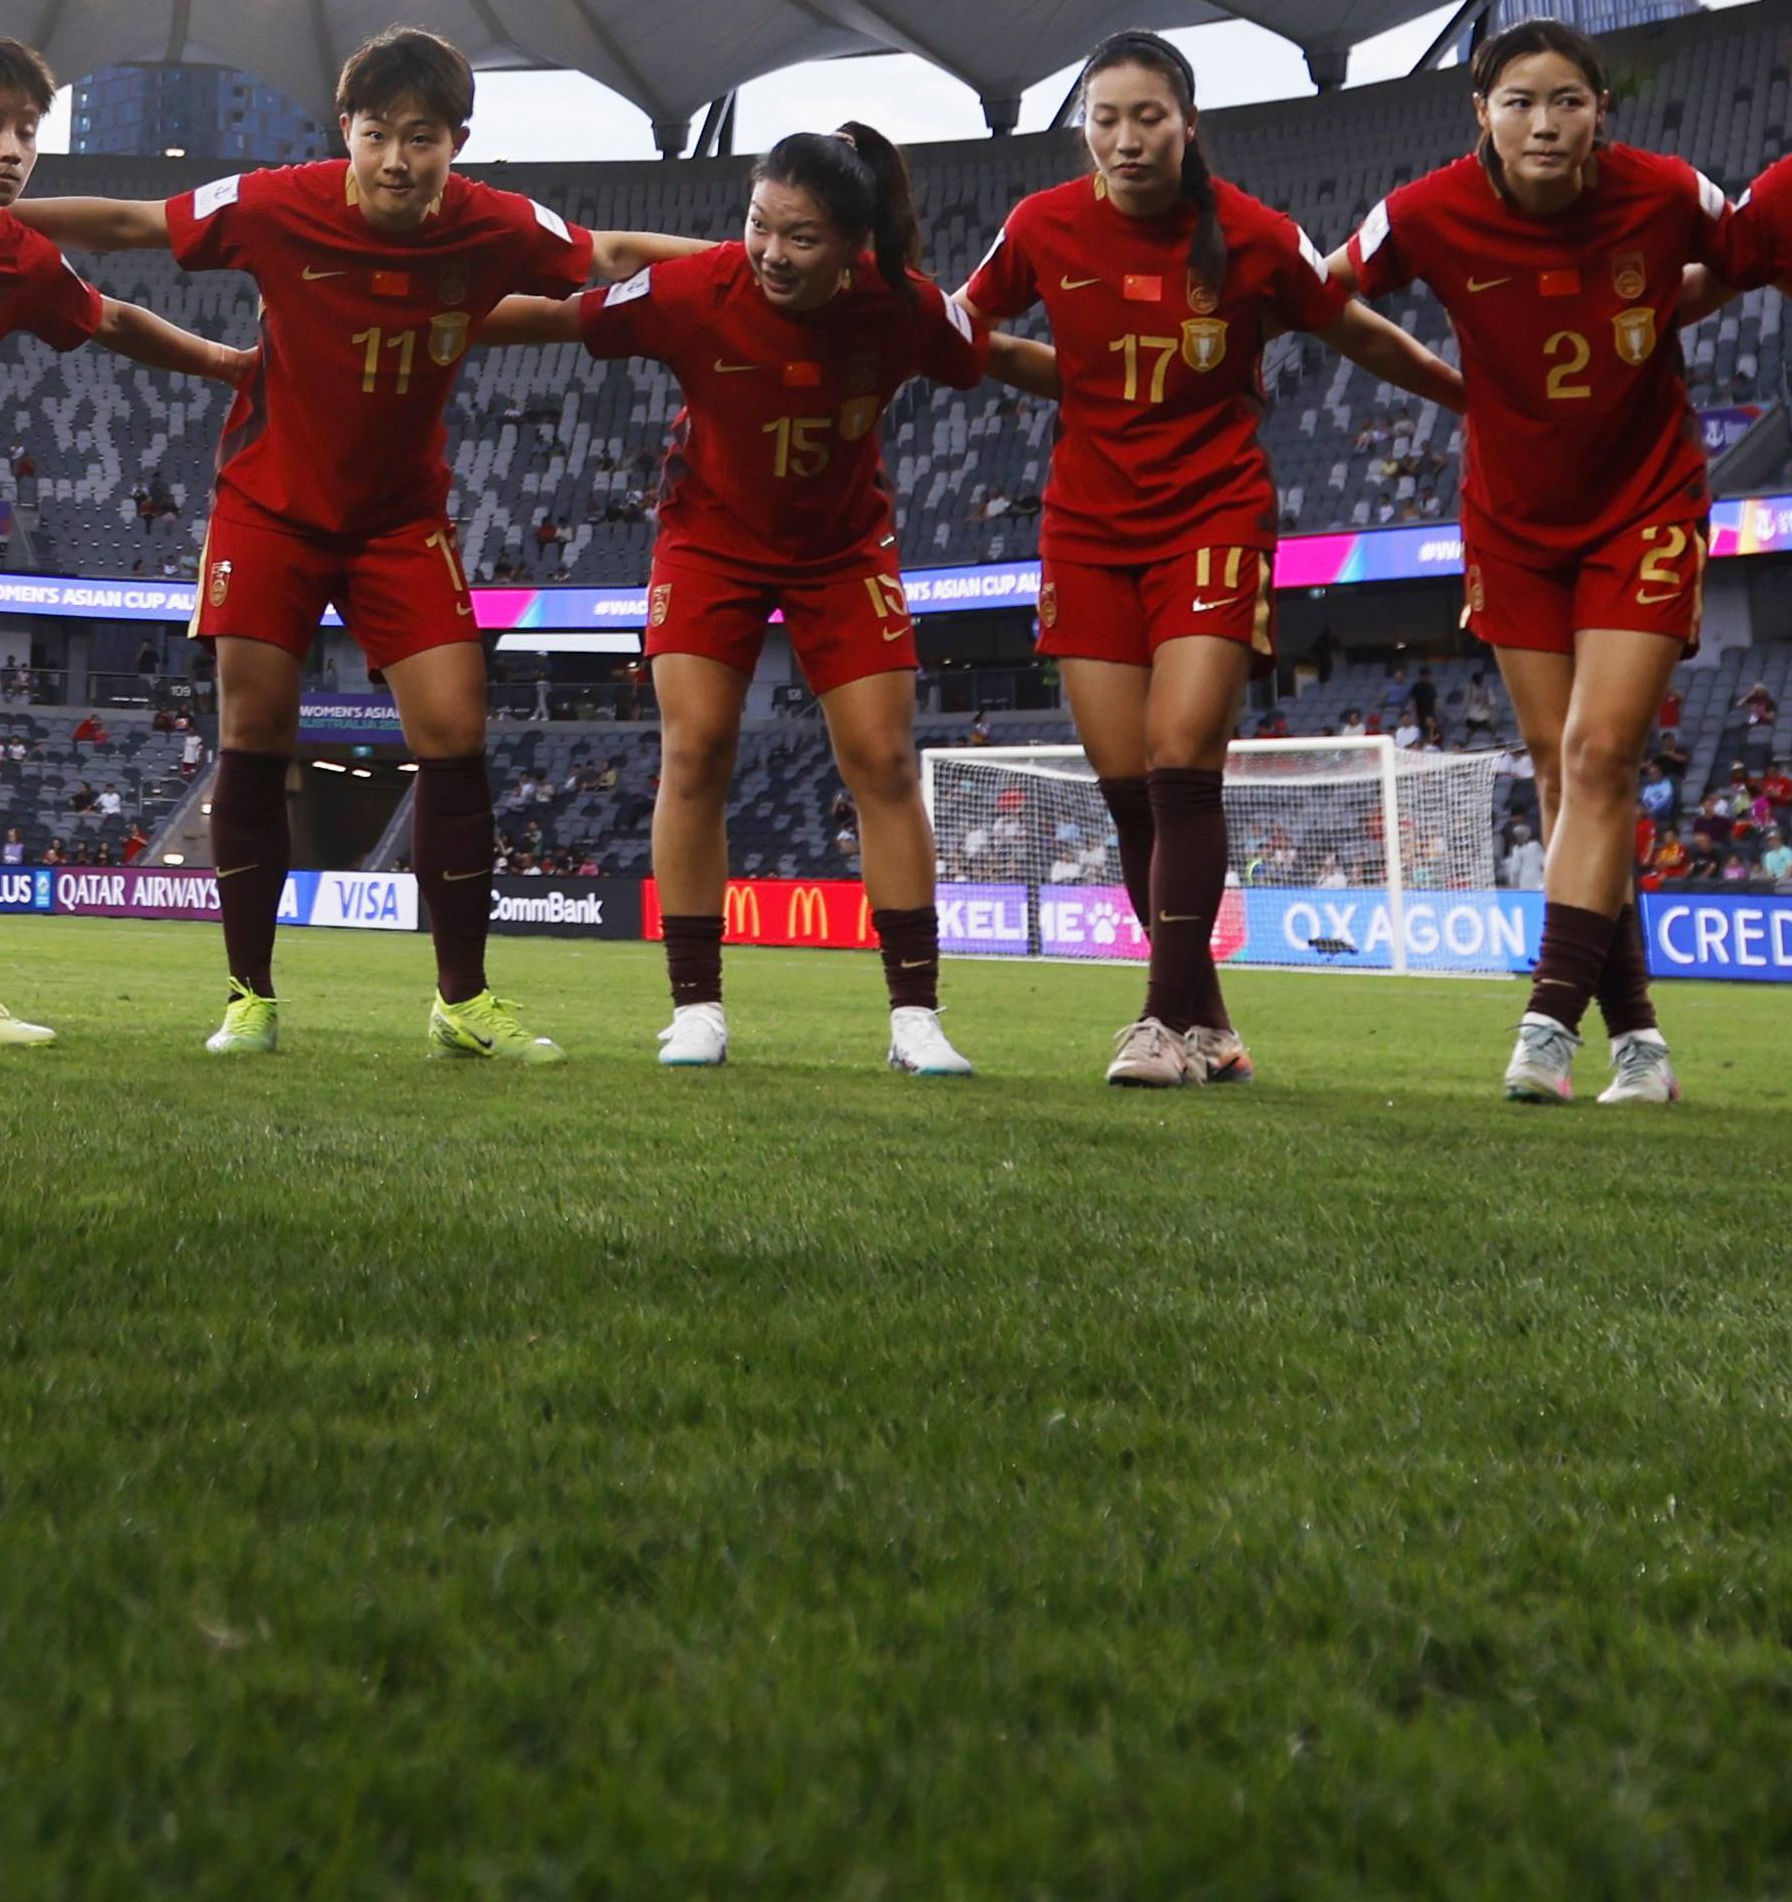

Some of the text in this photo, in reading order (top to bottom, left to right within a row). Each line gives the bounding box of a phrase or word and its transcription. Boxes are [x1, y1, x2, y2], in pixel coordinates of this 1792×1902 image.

[351, 327, 416, 395] 11
[1108, 333, 1179, 403] 17
[1543, 330, 1591, 399] 2
[762, 416, 832, 478] 15
[1640, 525, 1687, 584] 2
[63, 589, 123, 608] ASIAN
[125, 591, 165, 610] CUP
[931, 577, 982, 601] ASIAN
[982, 575, 1016, 597] CUP
[170, 685, 192, 698] 109
[299, 705, 363, 719] WOMEN'S
[56, 872, 219, 911] QATAR AIRWAYS
[332, 879, 399, 921] VISA
[1283, 902, 1526, 956] OXAGON
